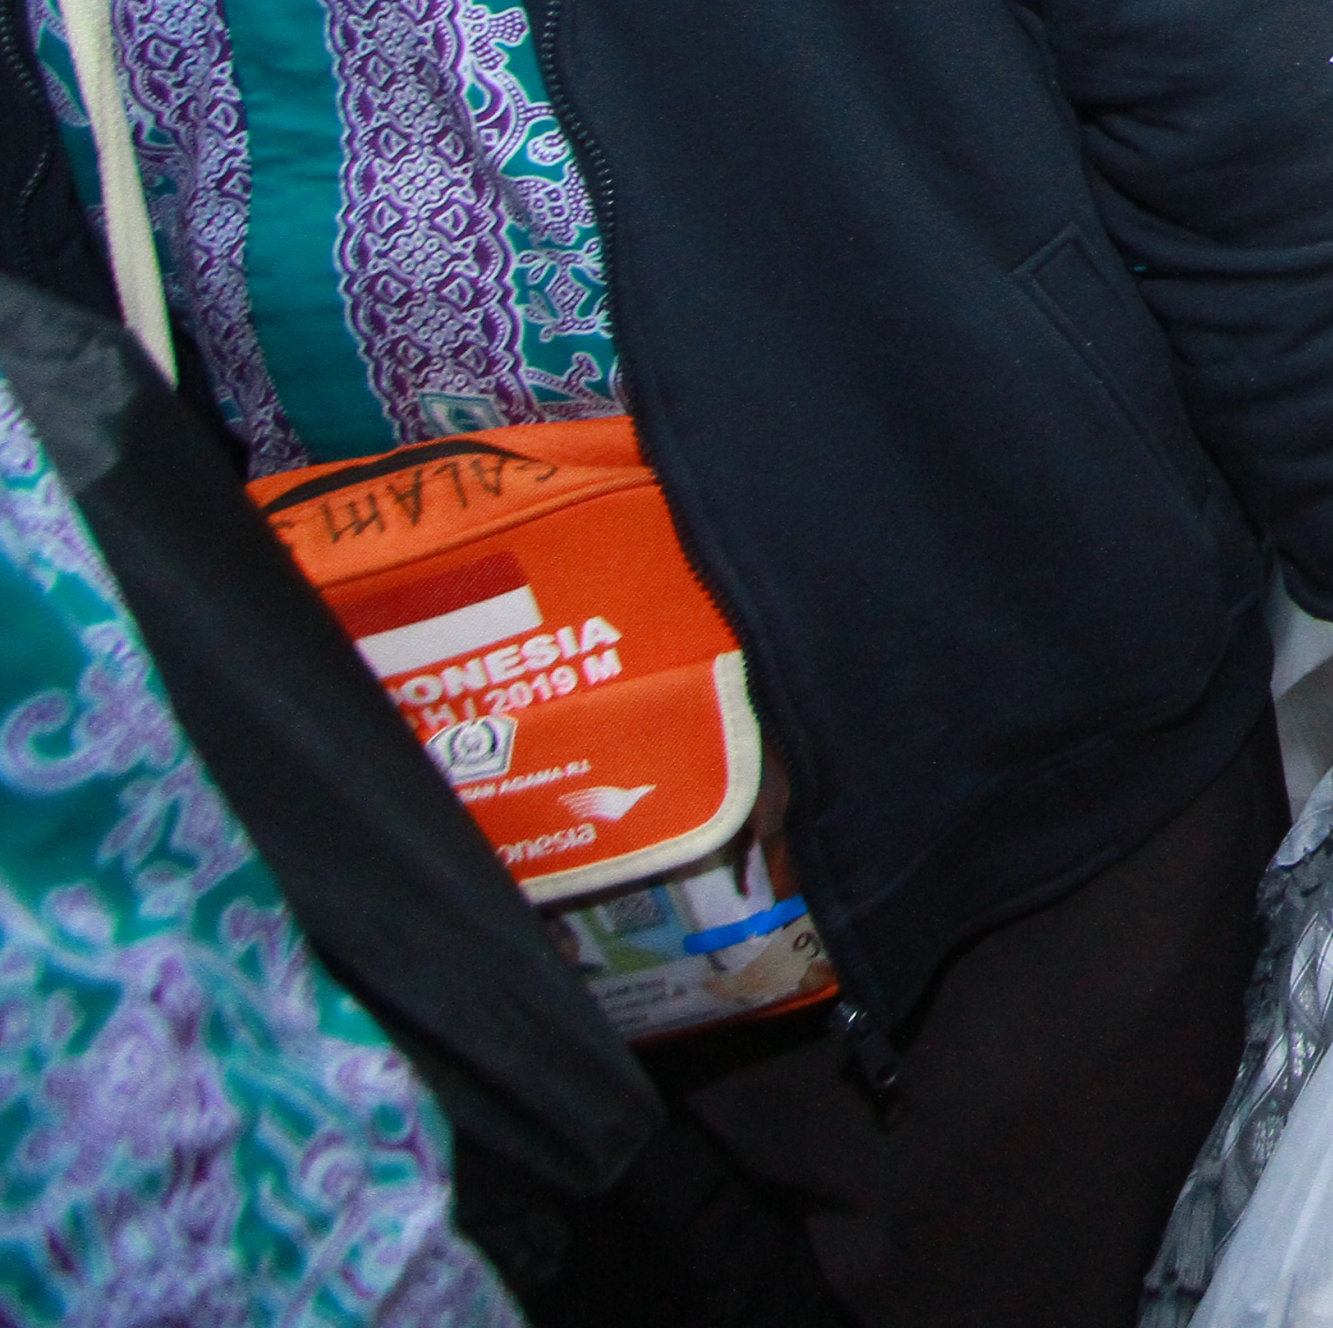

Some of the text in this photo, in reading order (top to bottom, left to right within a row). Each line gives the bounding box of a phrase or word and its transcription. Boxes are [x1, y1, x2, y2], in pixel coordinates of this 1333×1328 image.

[483, 665, 579, 717] 2019
[583, 647, 623, 686] M
[500, 766, 565, 795] AGAMA
